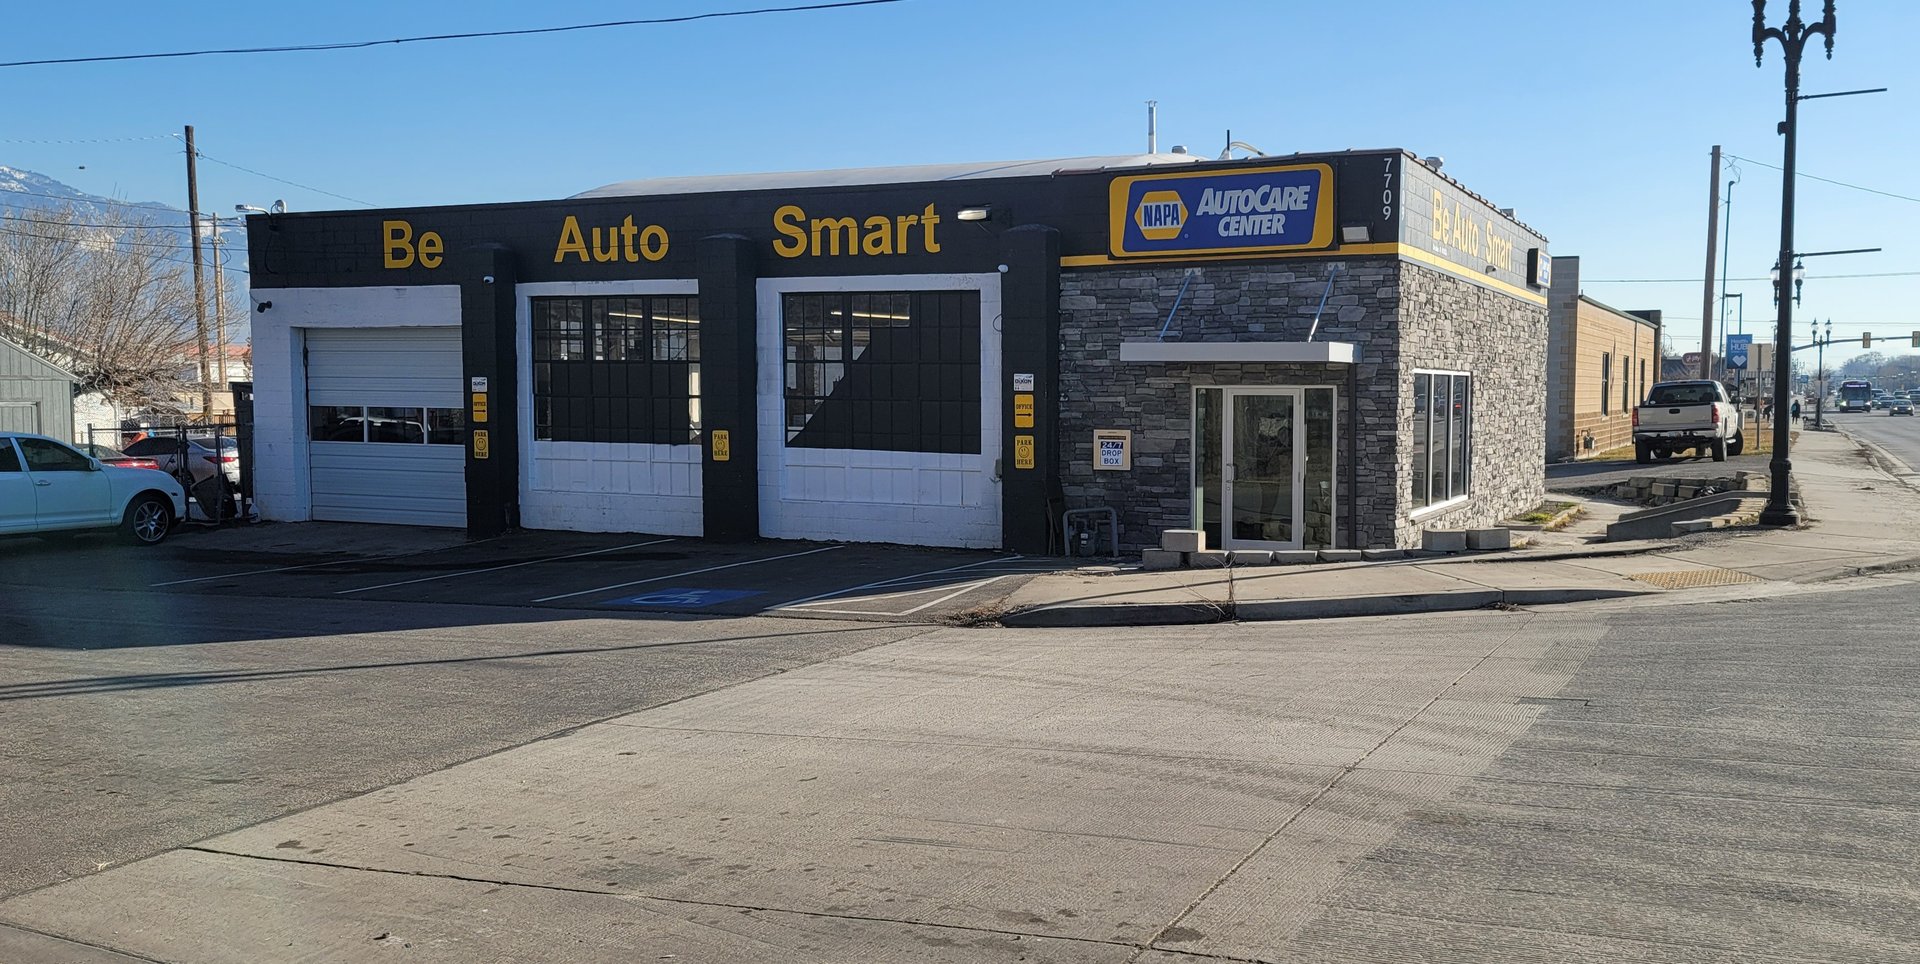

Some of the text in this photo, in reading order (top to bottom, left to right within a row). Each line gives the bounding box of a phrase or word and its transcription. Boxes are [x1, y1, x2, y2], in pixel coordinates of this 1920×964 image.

[1143, 203, 1180, 227] NAPA
[1383, 157, 1392, 220] 7709
[383, 202, 941, 269] Be Auto Smart
[1218, 213, 1286, 237] CENTER
[1432, 188, 1450, 245] Be
[1452, 202, 1479, 257] Auto
[1485, 220, 1512, 272] Smart
